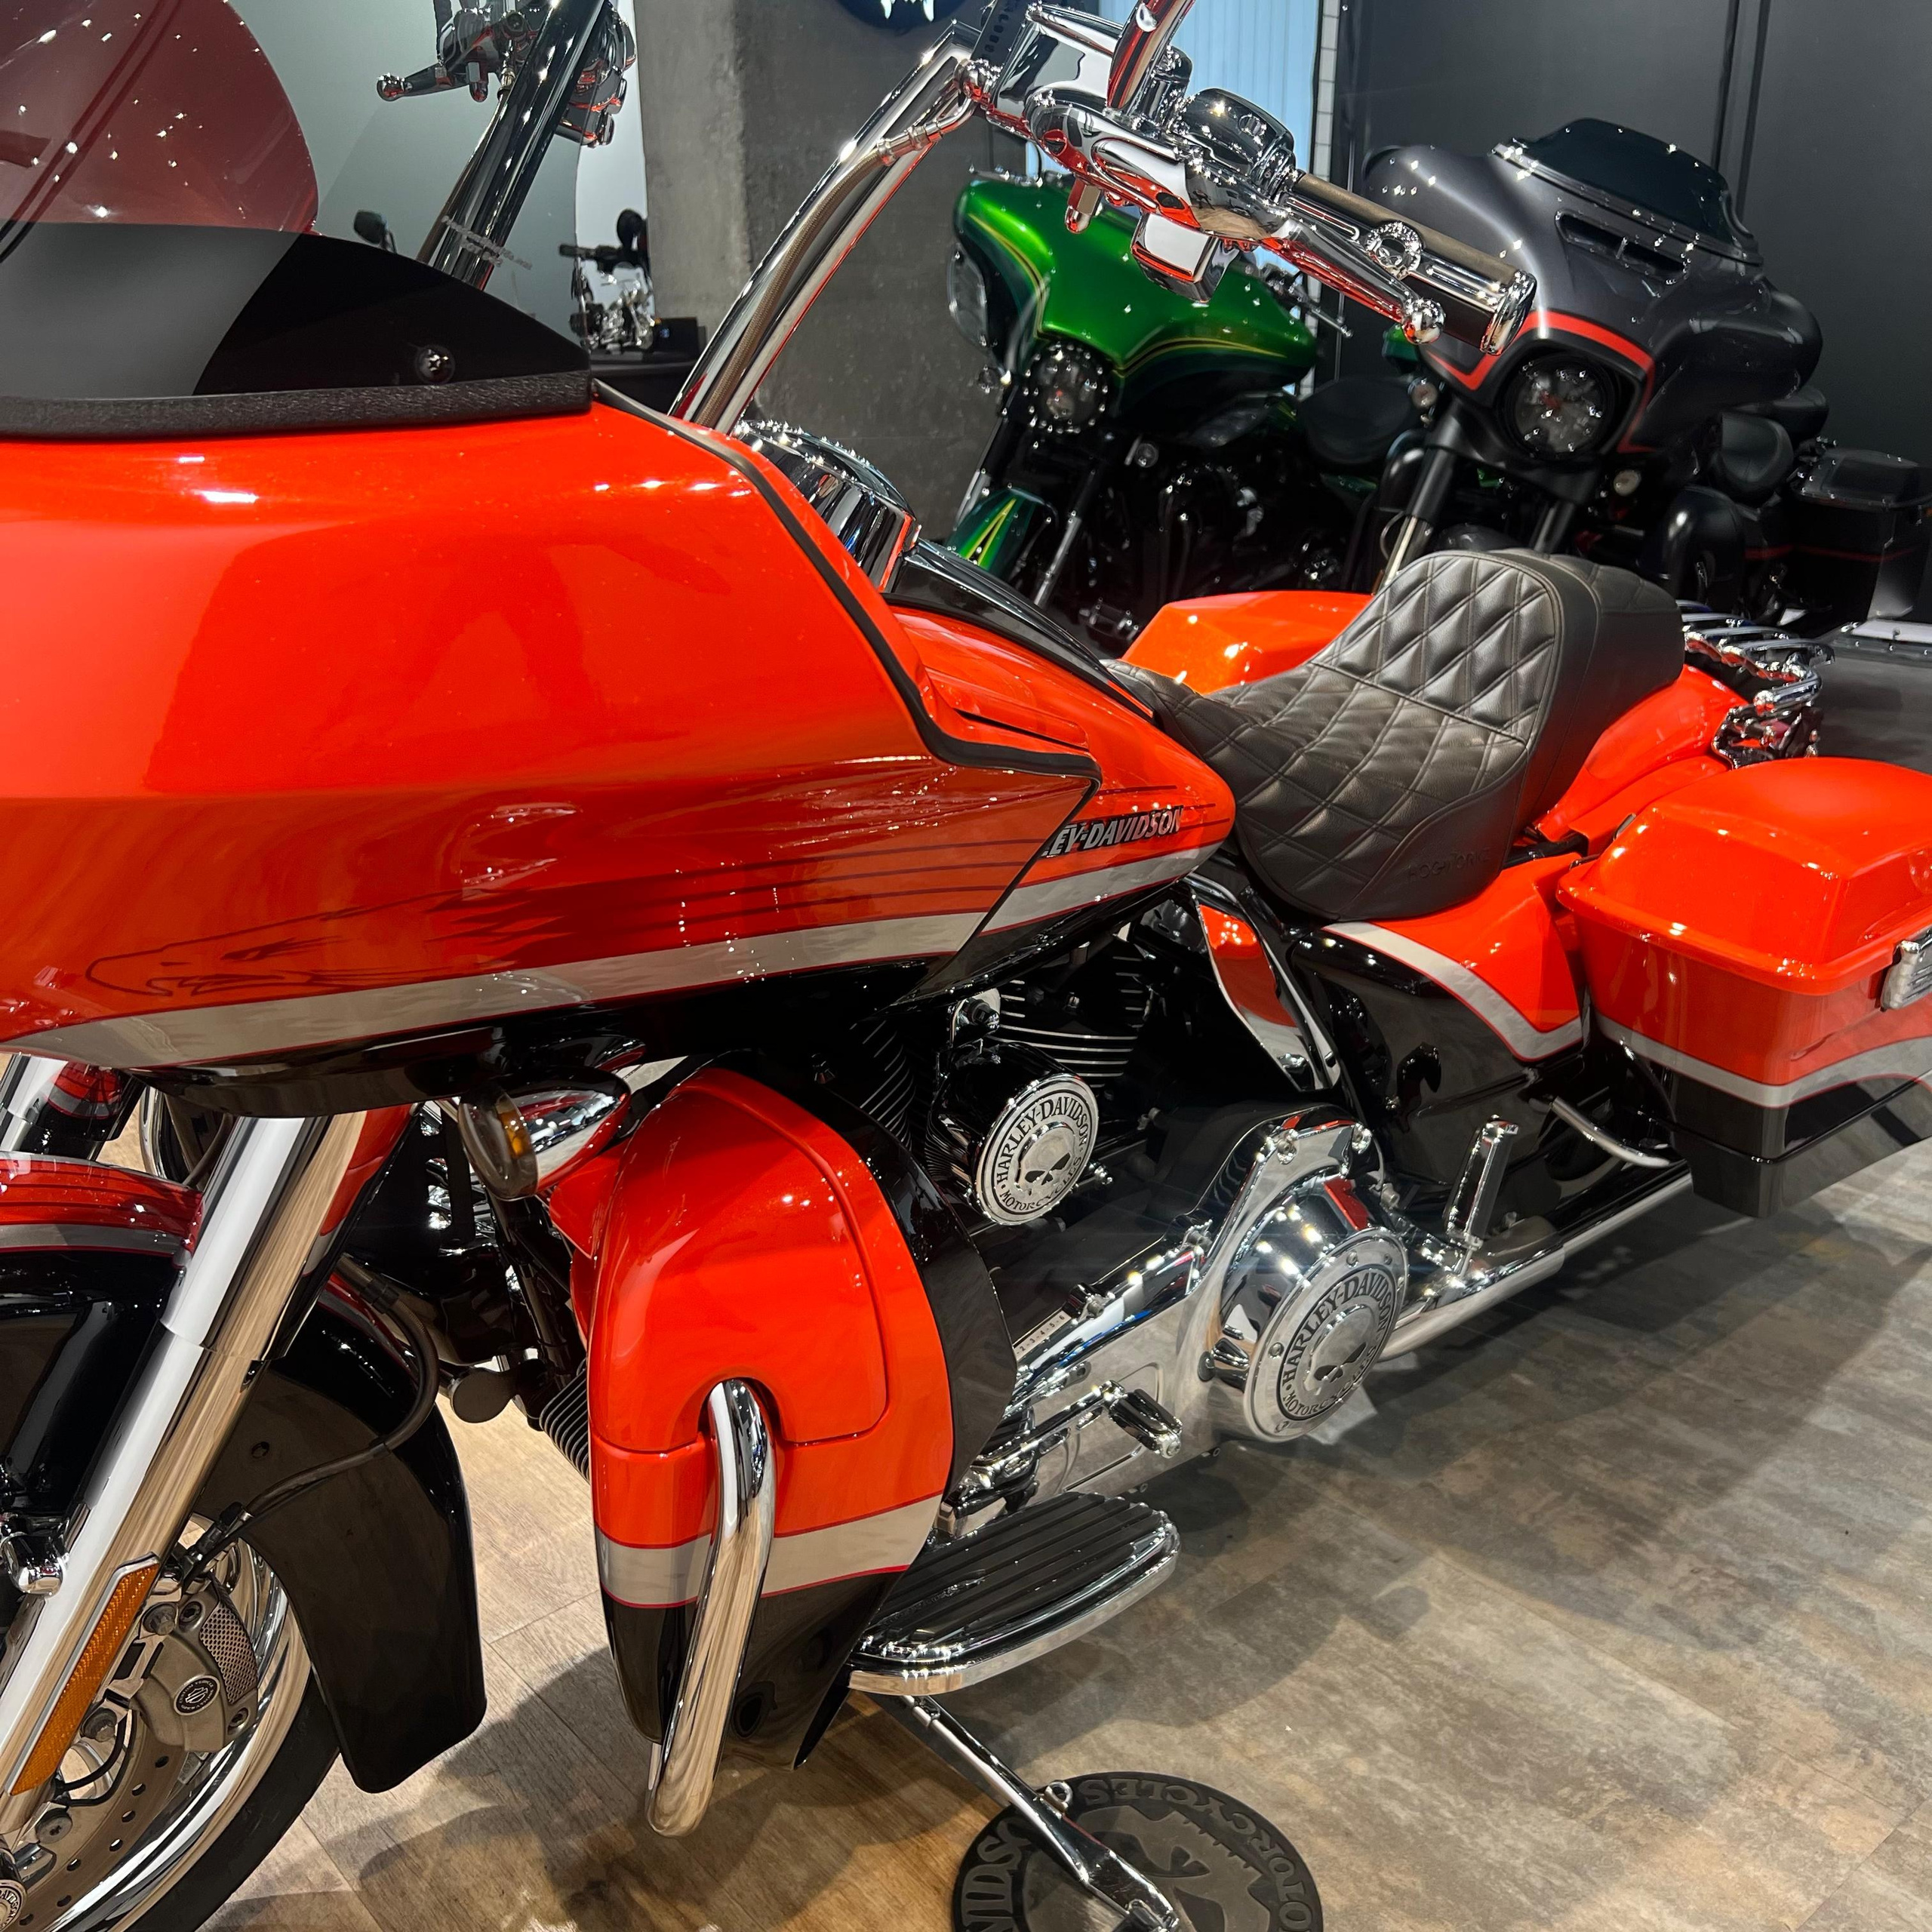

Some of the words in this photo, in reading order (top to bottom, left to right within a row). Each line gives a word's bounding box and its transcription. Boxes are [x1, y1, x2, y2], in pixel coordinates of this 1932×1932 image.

[1041, 807, 1183, 857] EY-DAVIDSON
[996, 1096, 1089, 1184] HARLEY-DAVIDSON
[999, 1156, 1081, 1211] MOTORCYCLES
[1282, 1272, 1393, 1386] HARLEY-DAVIDSON
[1078, 1778, 1312, 1932] OTORCYCLES
